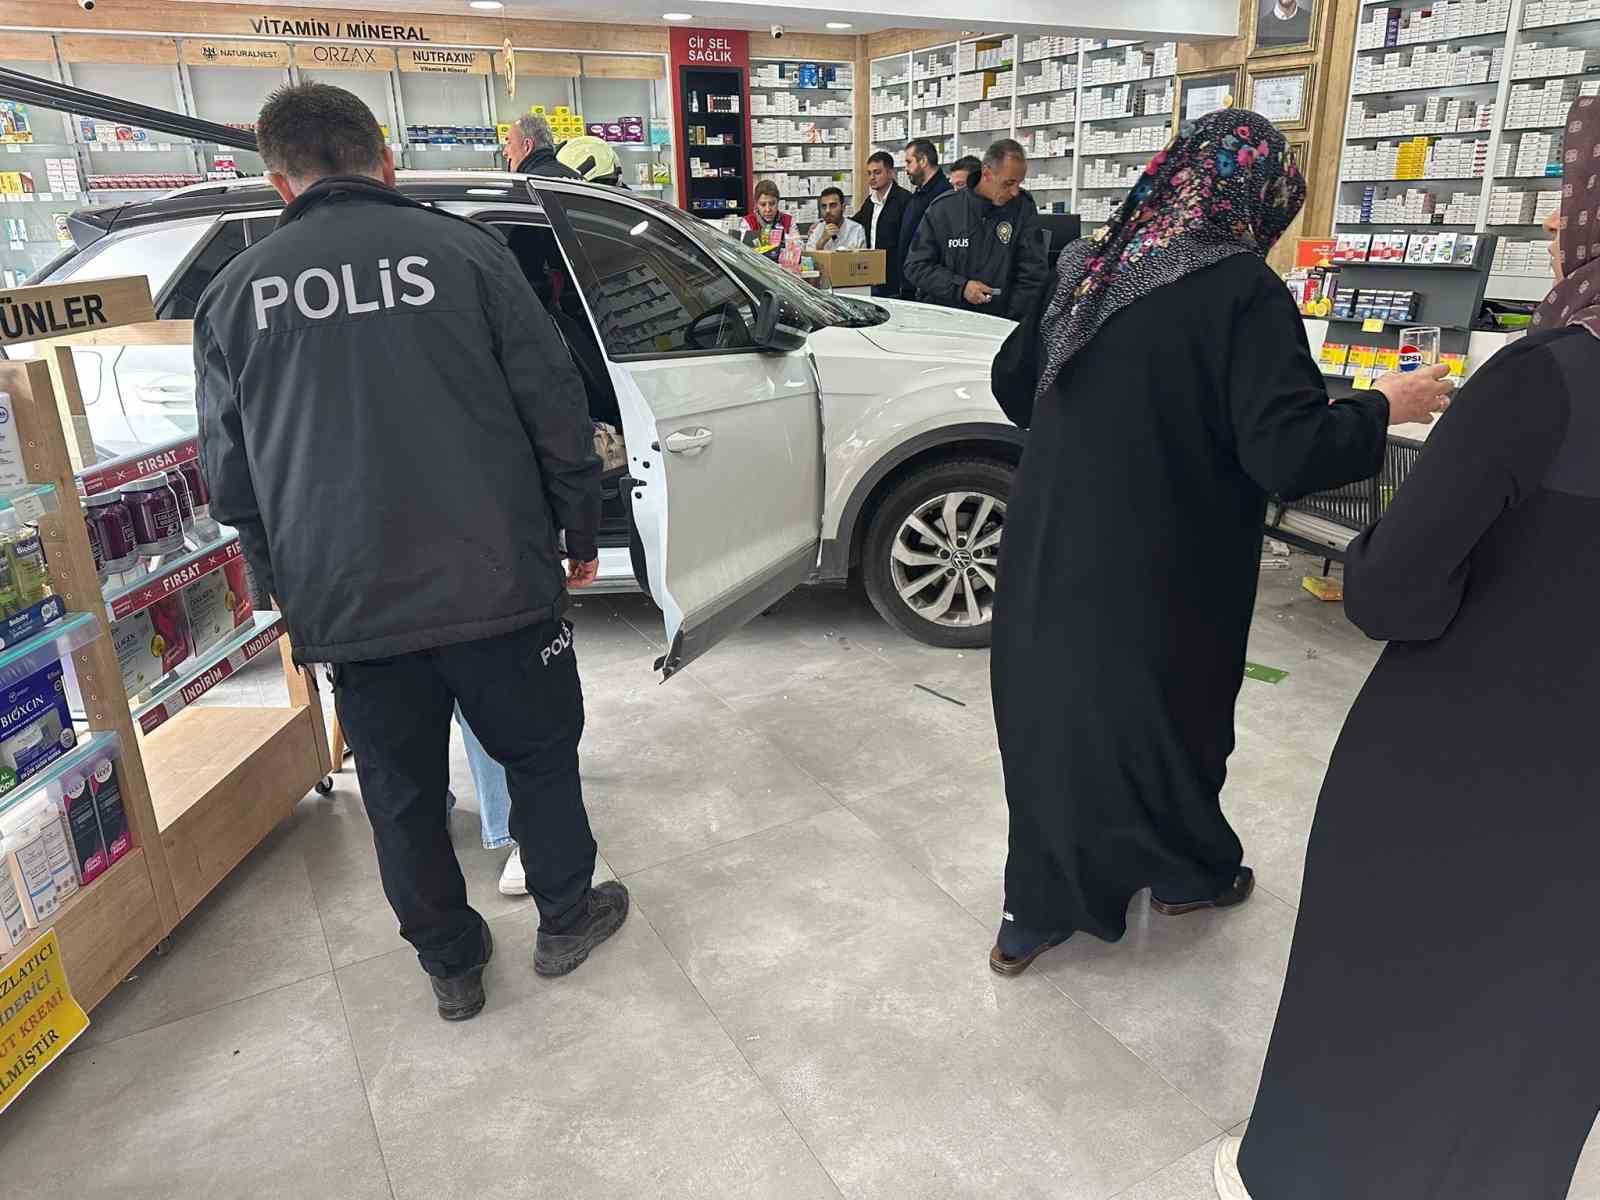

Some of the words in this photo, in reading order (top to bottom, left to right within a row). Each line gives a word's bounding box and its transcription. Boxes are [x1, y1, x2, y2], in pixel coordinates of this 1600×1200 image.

[250, 15, 329, 36] VİTAMİN
[347, 20, 430, 41] MİNERAL
[313, 46, 377, 63] ORZAX
[412, 50, 473, 63] NUTRAXIN
[688, 48, 732, 62] SAĞLIK
[0, 294, 108, 340] ÜNLER
[137, 450, 177, 474] FIRSAT
[162, 563, 201, 592] FIRSAT
[244, 625, 280, 657] İNDİRİM
[183, 667, 223, 703] İNDİRİM
[0, 942, 54, 998] ZLATICI
[19, 986, 64, 1039] KREMİ
[0, 1028, 60, 1094] LMİŞTİR
